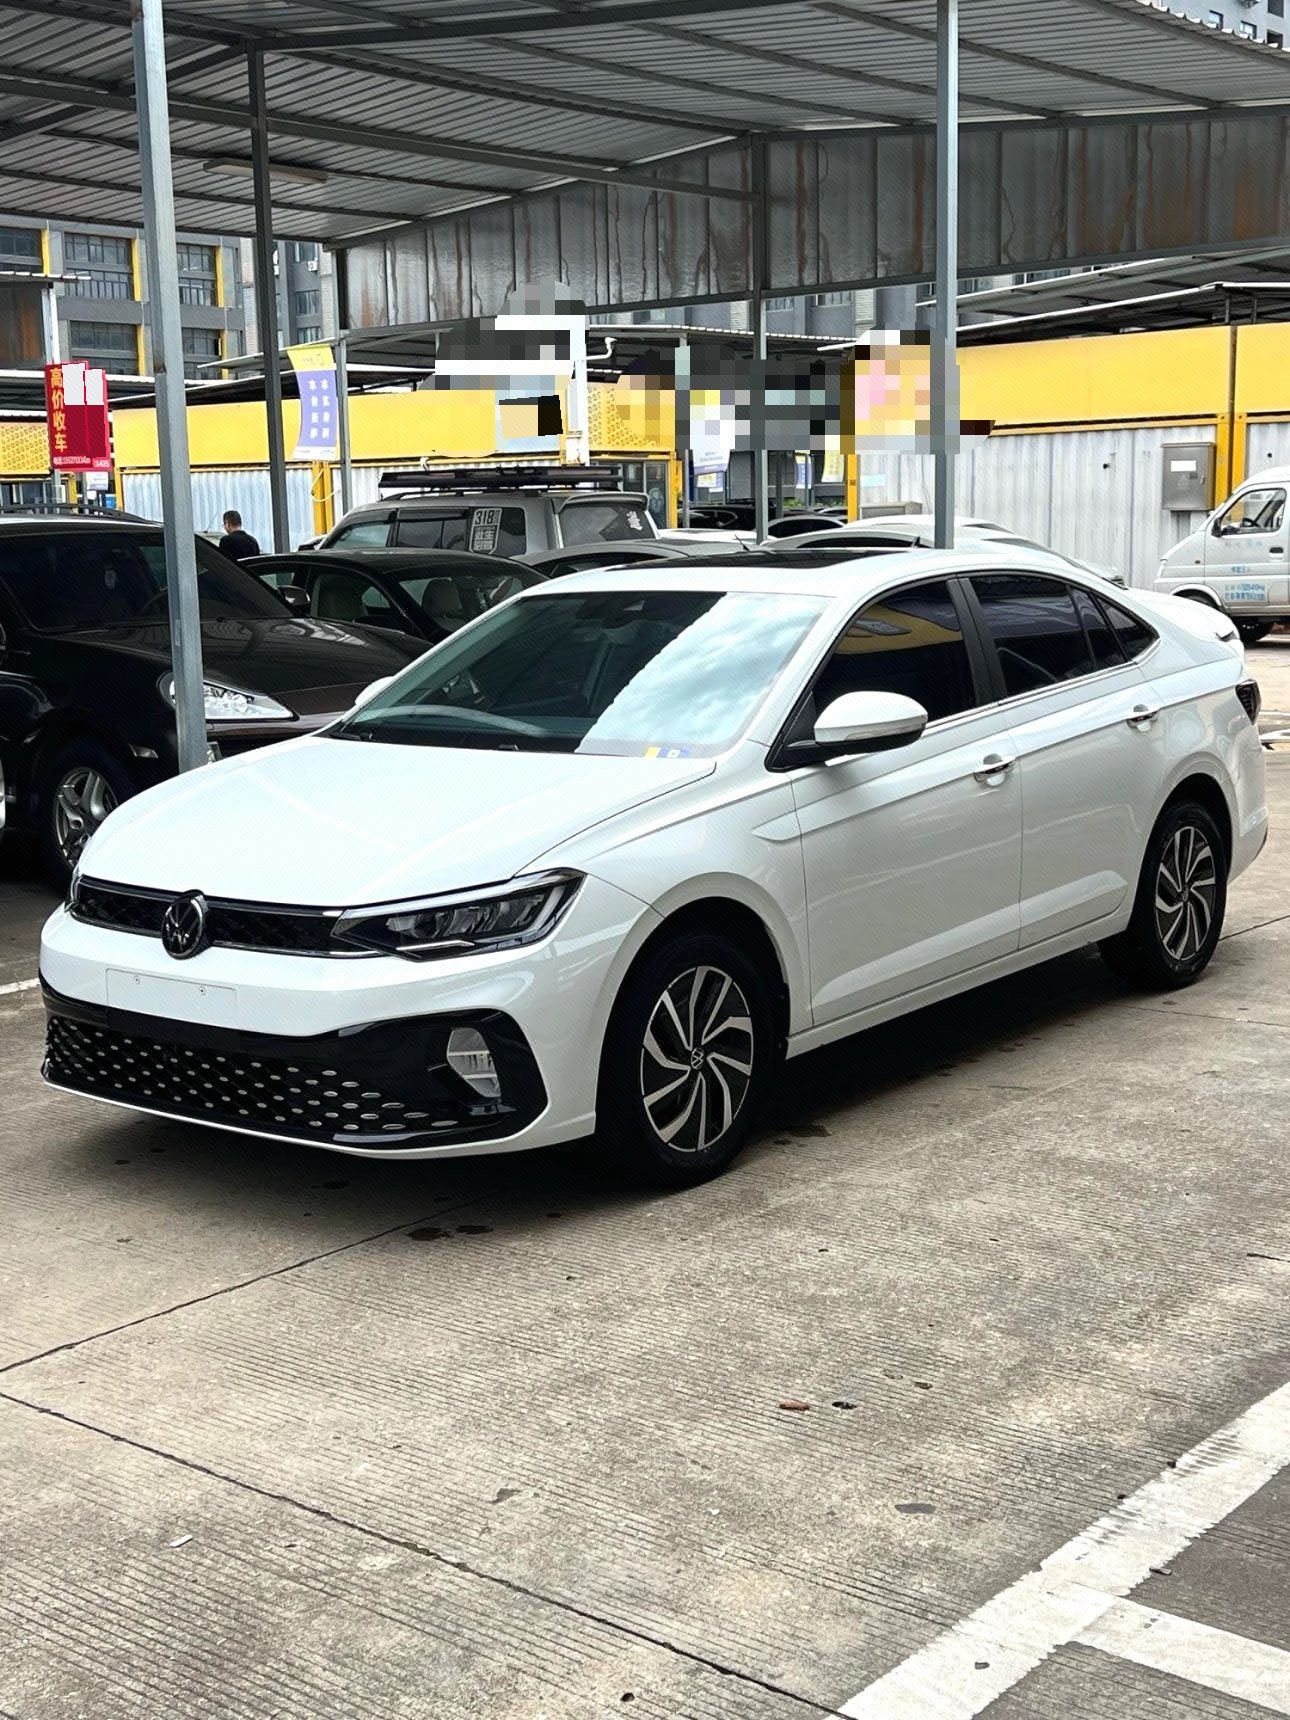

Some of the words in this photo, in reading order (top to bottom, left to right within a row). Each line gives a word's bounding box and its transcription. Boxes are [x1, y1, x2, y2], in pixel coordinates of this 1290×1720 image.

[50, 367, 67, 453] 高价收车
[475, 510, 495, 525] 318
